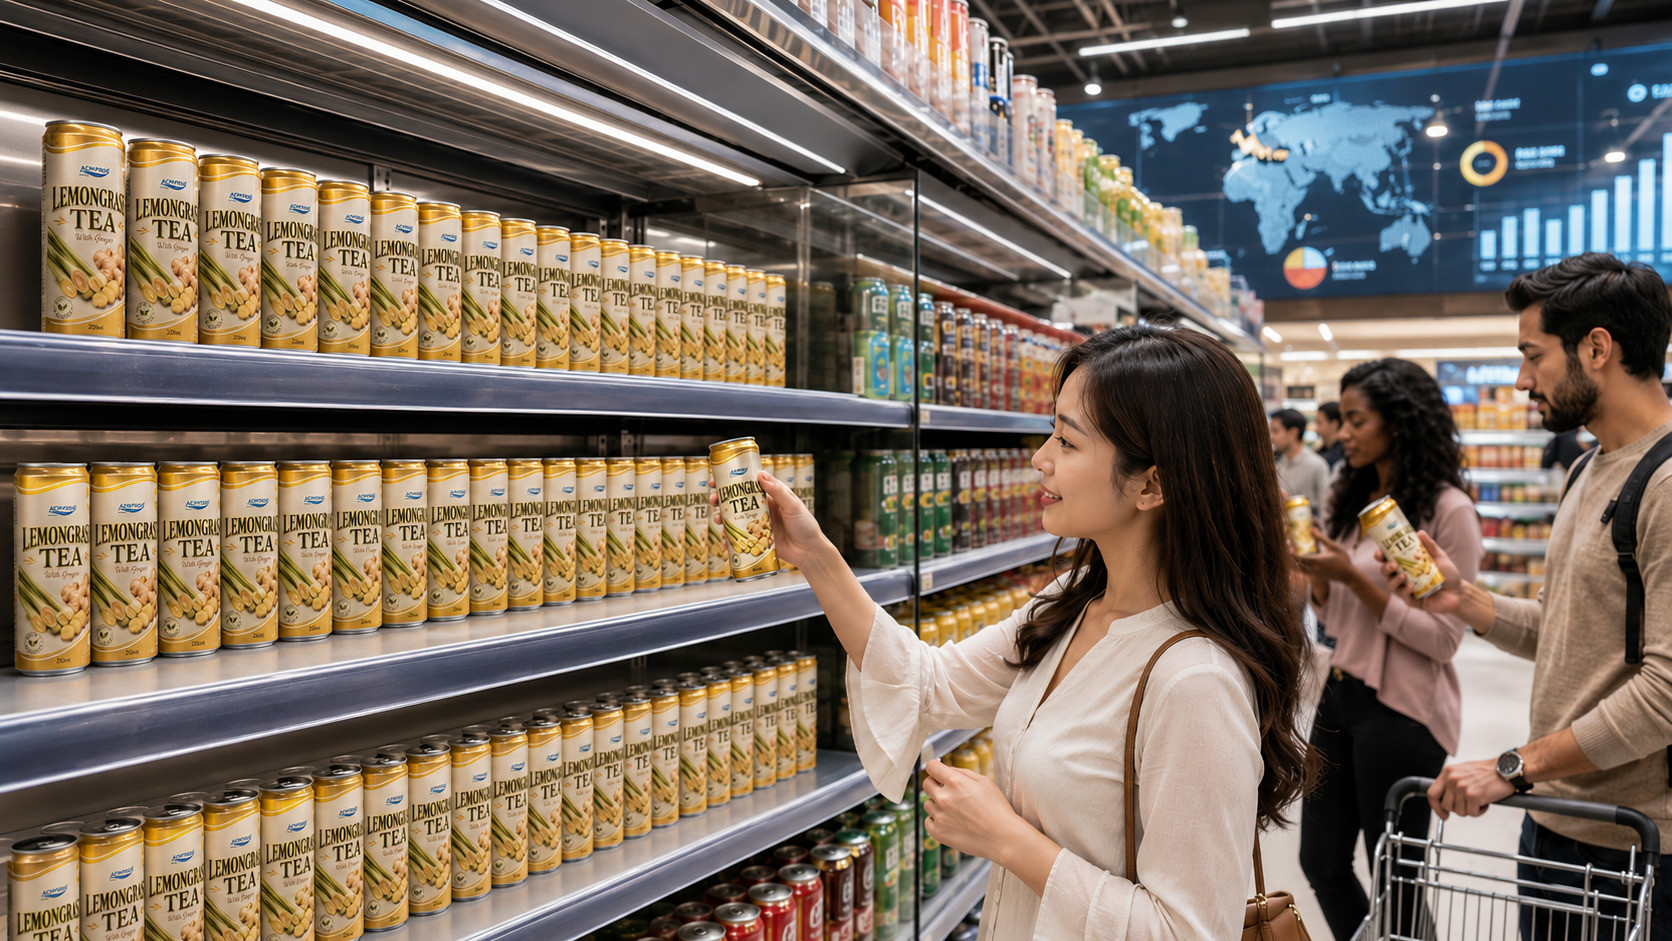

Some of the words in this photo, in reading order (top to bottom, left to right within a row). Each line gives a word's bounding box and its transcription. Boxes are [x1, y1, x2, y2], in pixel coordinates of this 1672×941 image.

[70, 209, 116, 234] TEA
[152, 219, 192, 242] TEA
[220, 230, 256, 252] TEA
[282, 240, 314, 262] TEA
[338, 249, 368, 270] TEA
[388, 258, 416, 277] TEA
[434, 266, 460, 284] TEA
[476, 272, 500, 289] TEA
[730, 496, 760, 514] TEA
[350, 527, 379, 545] TEA
[398, 524, 426, 542] TEA
[444, 522, 468, 538] TEA
[484, 518, 508, 535] TEA
[178, 538, 214, 558] TEA
[240, 534, 274, 554] TEA
[298, 530, 329, 550] TEA
[39, 546, 82, 568] TEA
[110, 542, 150, 564] TEA
[505, 793, 526, 810] TEA
[467, 803, 490, 822] TEA
[424, 816, 450, 835] TEA
[380, 827, 406, 848] TEA
[333, 840, 361, 862] TEA
[280, 856, 311, 878] TEA
[224, 871, 256, 894] TEA
[164, 887, 200, 912] TEA
[101, 905, 139, 932] TEA
[33, 924, 74, 941] TEA
